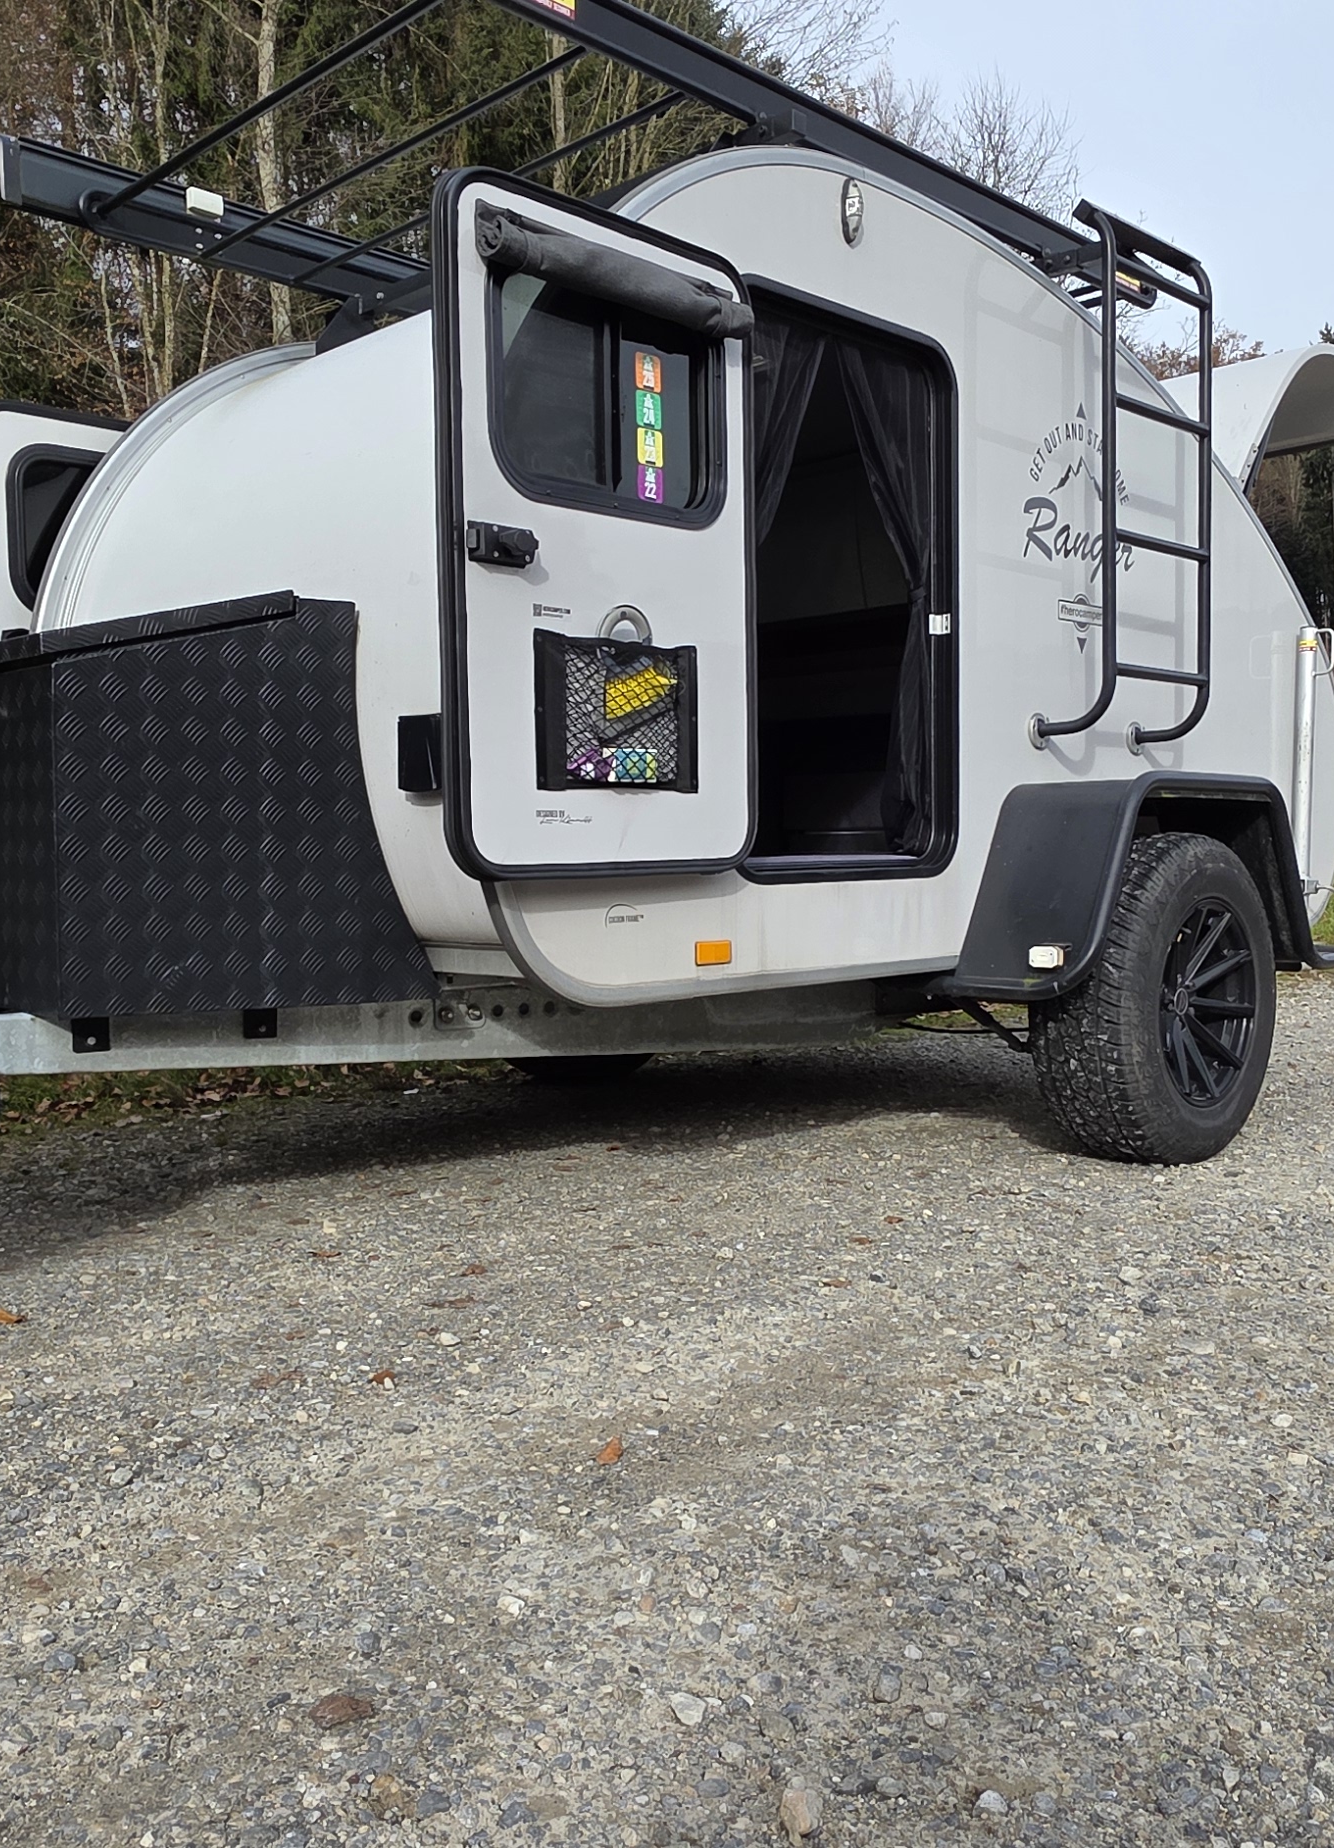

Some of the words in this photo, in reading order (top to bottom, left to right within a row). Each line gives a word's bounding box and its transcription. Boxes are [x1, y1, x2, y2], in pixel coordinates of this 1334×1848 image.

[643, 407, 655, 426] 24
[1029, 447, 1046, 482] GET
[1043, 426, 1062, 454] OUT
[1065, 422, 1084, 441] AND
[1087, 428, 1103, 455] STA
[644, 482, 657, 499] 22
